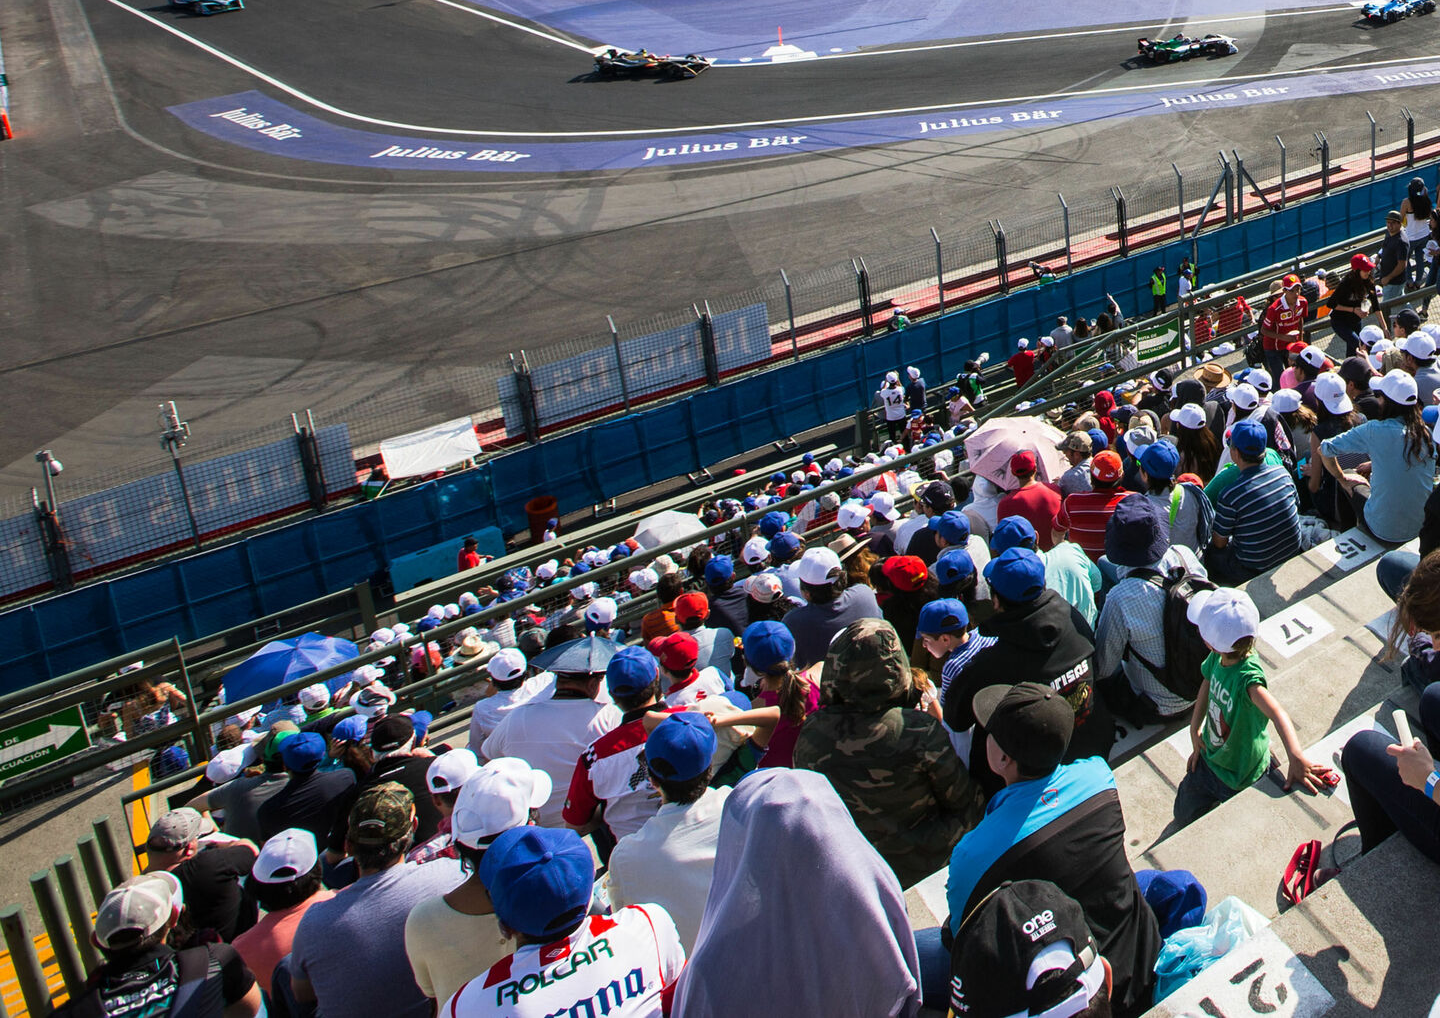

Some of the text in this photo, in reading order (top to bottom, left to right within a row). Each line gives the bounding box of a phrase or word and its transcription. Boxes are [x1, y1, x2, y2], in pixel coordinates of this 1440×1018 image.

[1160, 85, 1290, 108] Julius Bär
[210, 108, 303, 141] Julius Bär
[919, 109, 1063, 133] Julius Bär
[370, 145, 530, 163] Julius Bär
[643, 134, 808, 160] Julius Bär
[886, 394, 902, 407] 14
[1335, 537, 1367, 560] 15
[1280, 617, 1313, 646] 17
[4, 736, 20, 747] DE
[1022, 909, 1055, 935] one
[496, 938, 615, 1007] ROLCAR
